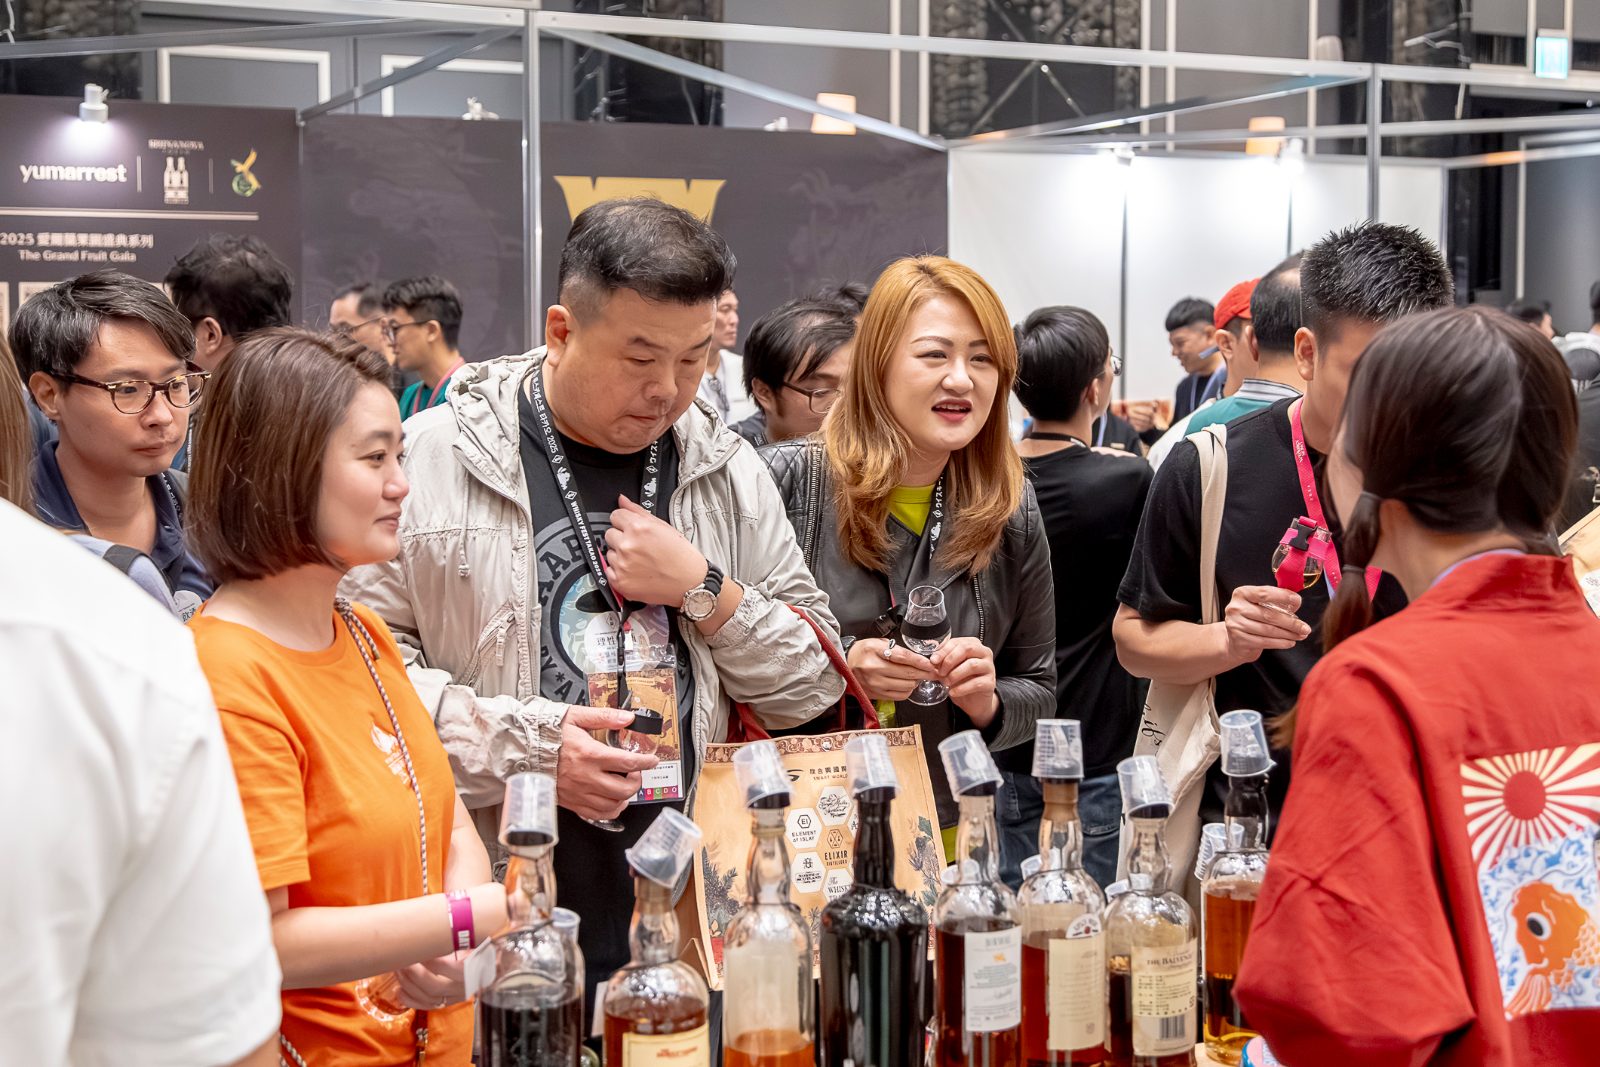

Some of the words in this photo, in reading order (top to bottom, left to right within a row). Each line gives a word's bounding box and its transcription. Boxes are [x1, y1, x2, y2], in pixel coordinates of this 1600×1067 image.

[20, 164, 127, 183] yumarrest
[0, 232, 35, 246] 2025
[19, 250, 41, 261] The
[43, 250, 79, 262] Grand
[81, 250, 107, 262] Fruit
[109, 251, 137, 262] Gala
[546, 435, 559, 454] 2025
[569, 501, 585, 526] WHISKY
[579, 525, 590, 540] FEST
[584, 539, 598, 561] TAKAO
[824, 850, 848, 860] ELIXIR
